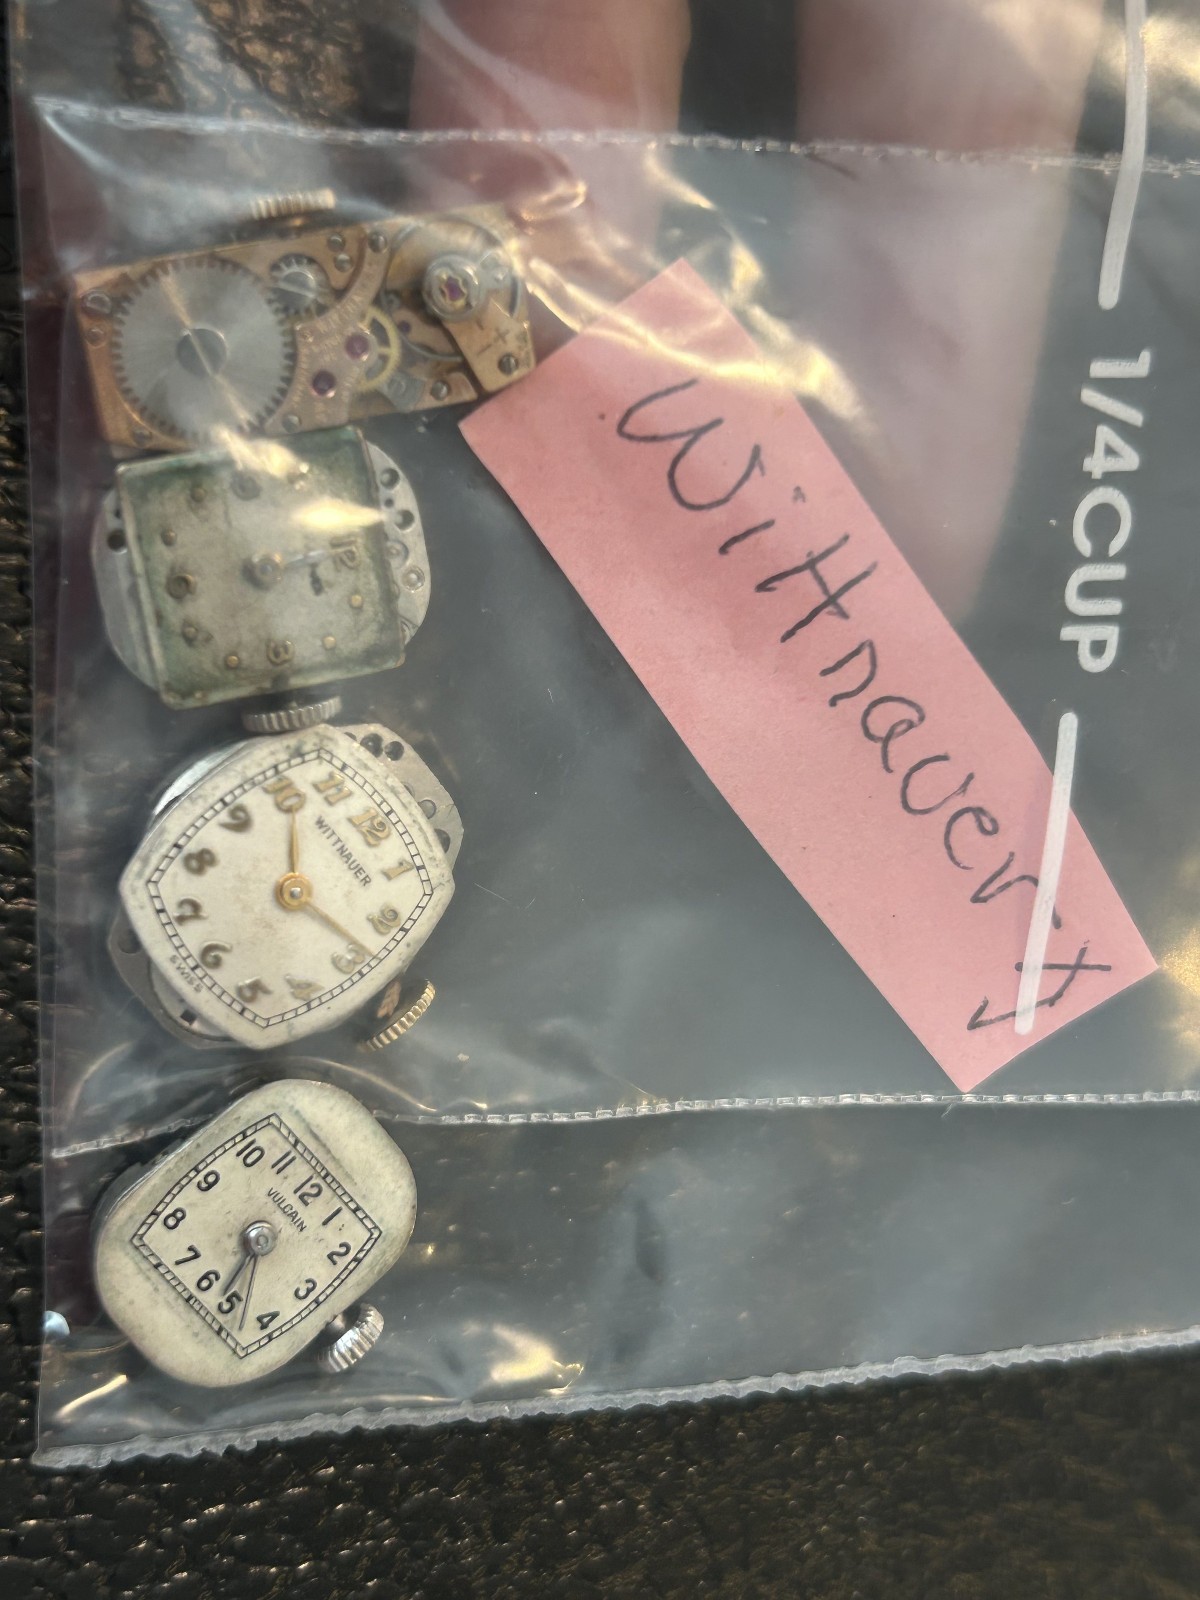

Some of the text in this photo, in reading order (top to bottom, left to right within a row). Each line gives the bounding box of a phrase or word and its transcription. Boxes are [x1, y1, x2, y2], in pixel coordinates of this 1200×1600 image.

[266, 639, 294, 666] 3
[262, 775, 306, 812] 10
[312, 771, 354, 805] 11
[219, 804, 253, 833] 9
[347, 806, 392, 847] 12
[183, 848, 219, 875] 8
[314, 815, 372, 887] WITTNAUER
[381, 861, 414, 880] 1
[173, 898, 208, 926] 7
[367, 904, 401, 935] 2
[201, 942, 232, 969] 6
[331, 944, 365, 974] 3
[236, 976, 272, 1003] 5
[284, 974, 324, 1000] 4
[235, 1138, 265, 1167] 10
[271, 1150, 297, 1174] 11
[196, 1169, 220, 1192] 9
[293, 1174, 323, 1206] 12
[163, 1206, 187, 1230] 8
[267, 1187, 307, 1232] VULCAIN
[322, 1206, 343, 1225] 1
[174, 1244, 201, 1266] 7
[327, 1241, 351, 1265] 2
[196, 1268, 220, 1292] 6
[294, 1277, 317, 1300] 3
[218, 1290, 243, 1314] 5
[256, 1310, 280, 1330] 4
